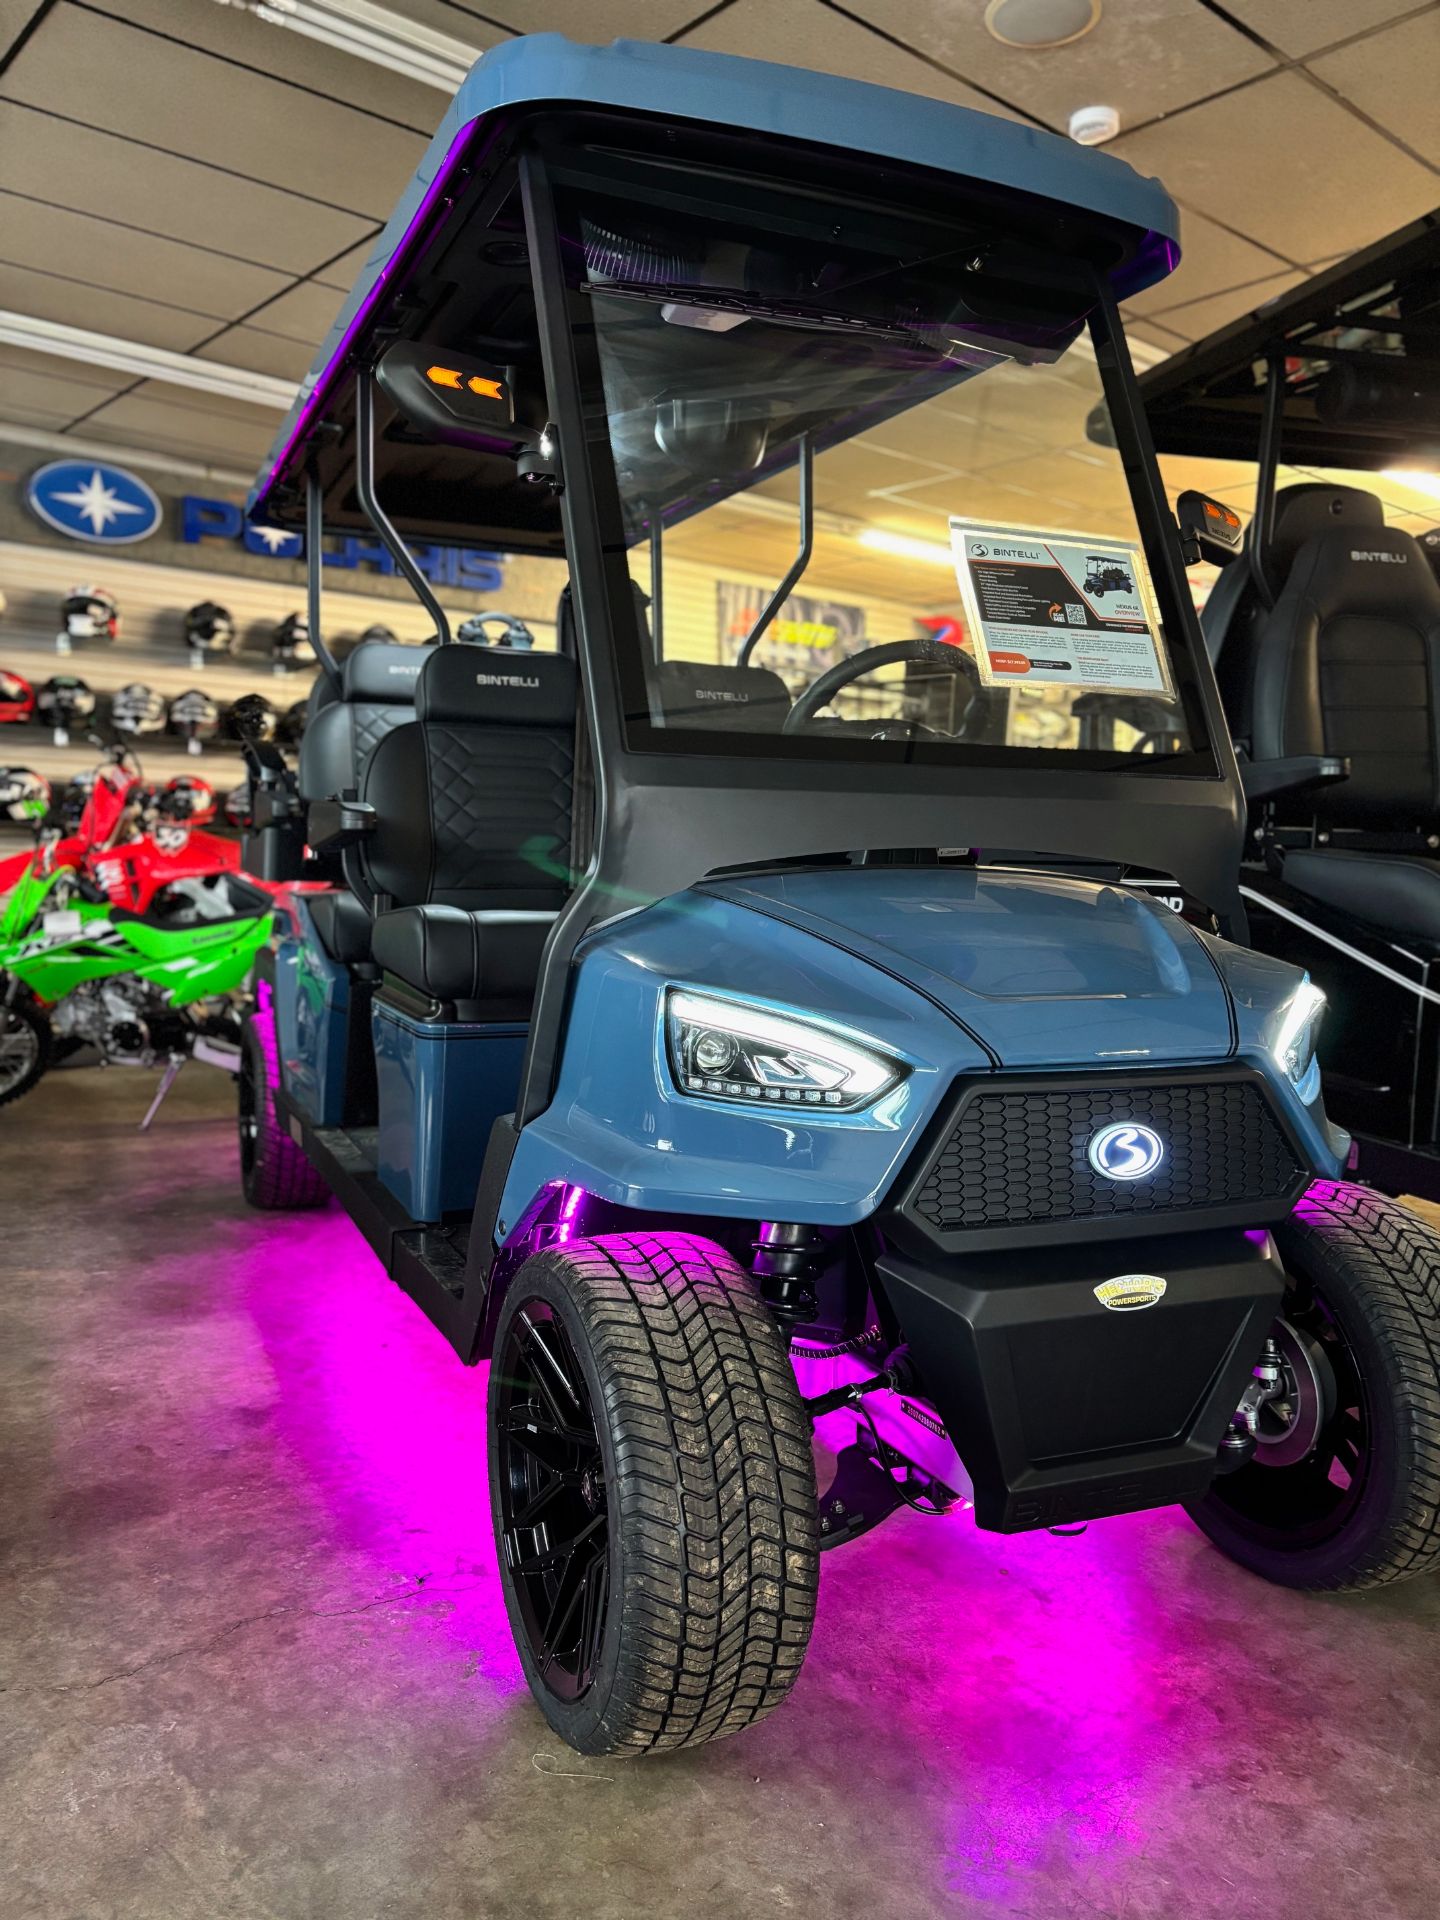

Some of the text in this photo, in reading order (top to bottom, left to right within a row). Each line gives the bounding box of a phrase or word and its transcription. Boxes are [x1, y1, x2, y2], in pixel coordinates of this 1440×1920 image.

[993, 548, 1040, 560] BINTELLI
[1351, 550, 1407, 563] BINTELLI
[1114, 609, 1141, 617] OVERVIEW
[476, 673, 540, 688] BINTELLI
[696, 689, 749, 702] BINTELLI
[1108, 1295, 1157, 1306] POWERSPORTS
